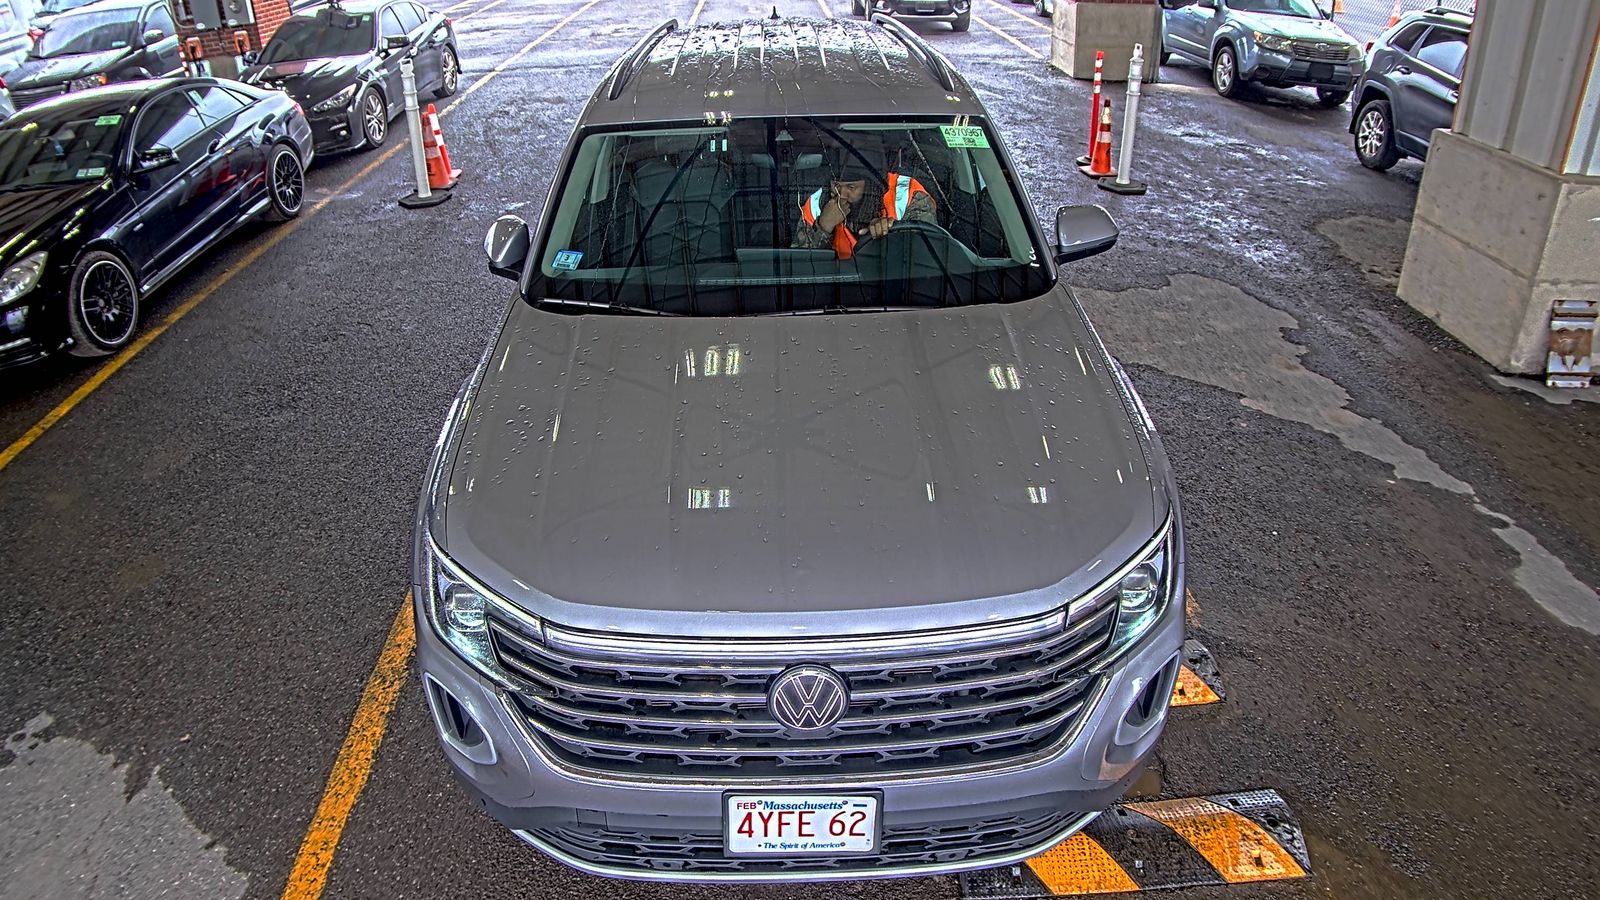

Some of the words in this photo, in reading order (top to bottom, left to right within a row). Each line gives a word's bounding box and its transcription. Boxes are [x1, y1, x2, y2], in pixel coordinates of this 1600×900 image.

[944, 127, 983, 137] 4370967
[736, 802, 757, 810] FEB
[763, 801, 843, 811] Massachusetts
[737, 811, 815, 838] 4YFE
[829, 810, 867, 837] 62
[779, 842, 799, 850] Spirit
